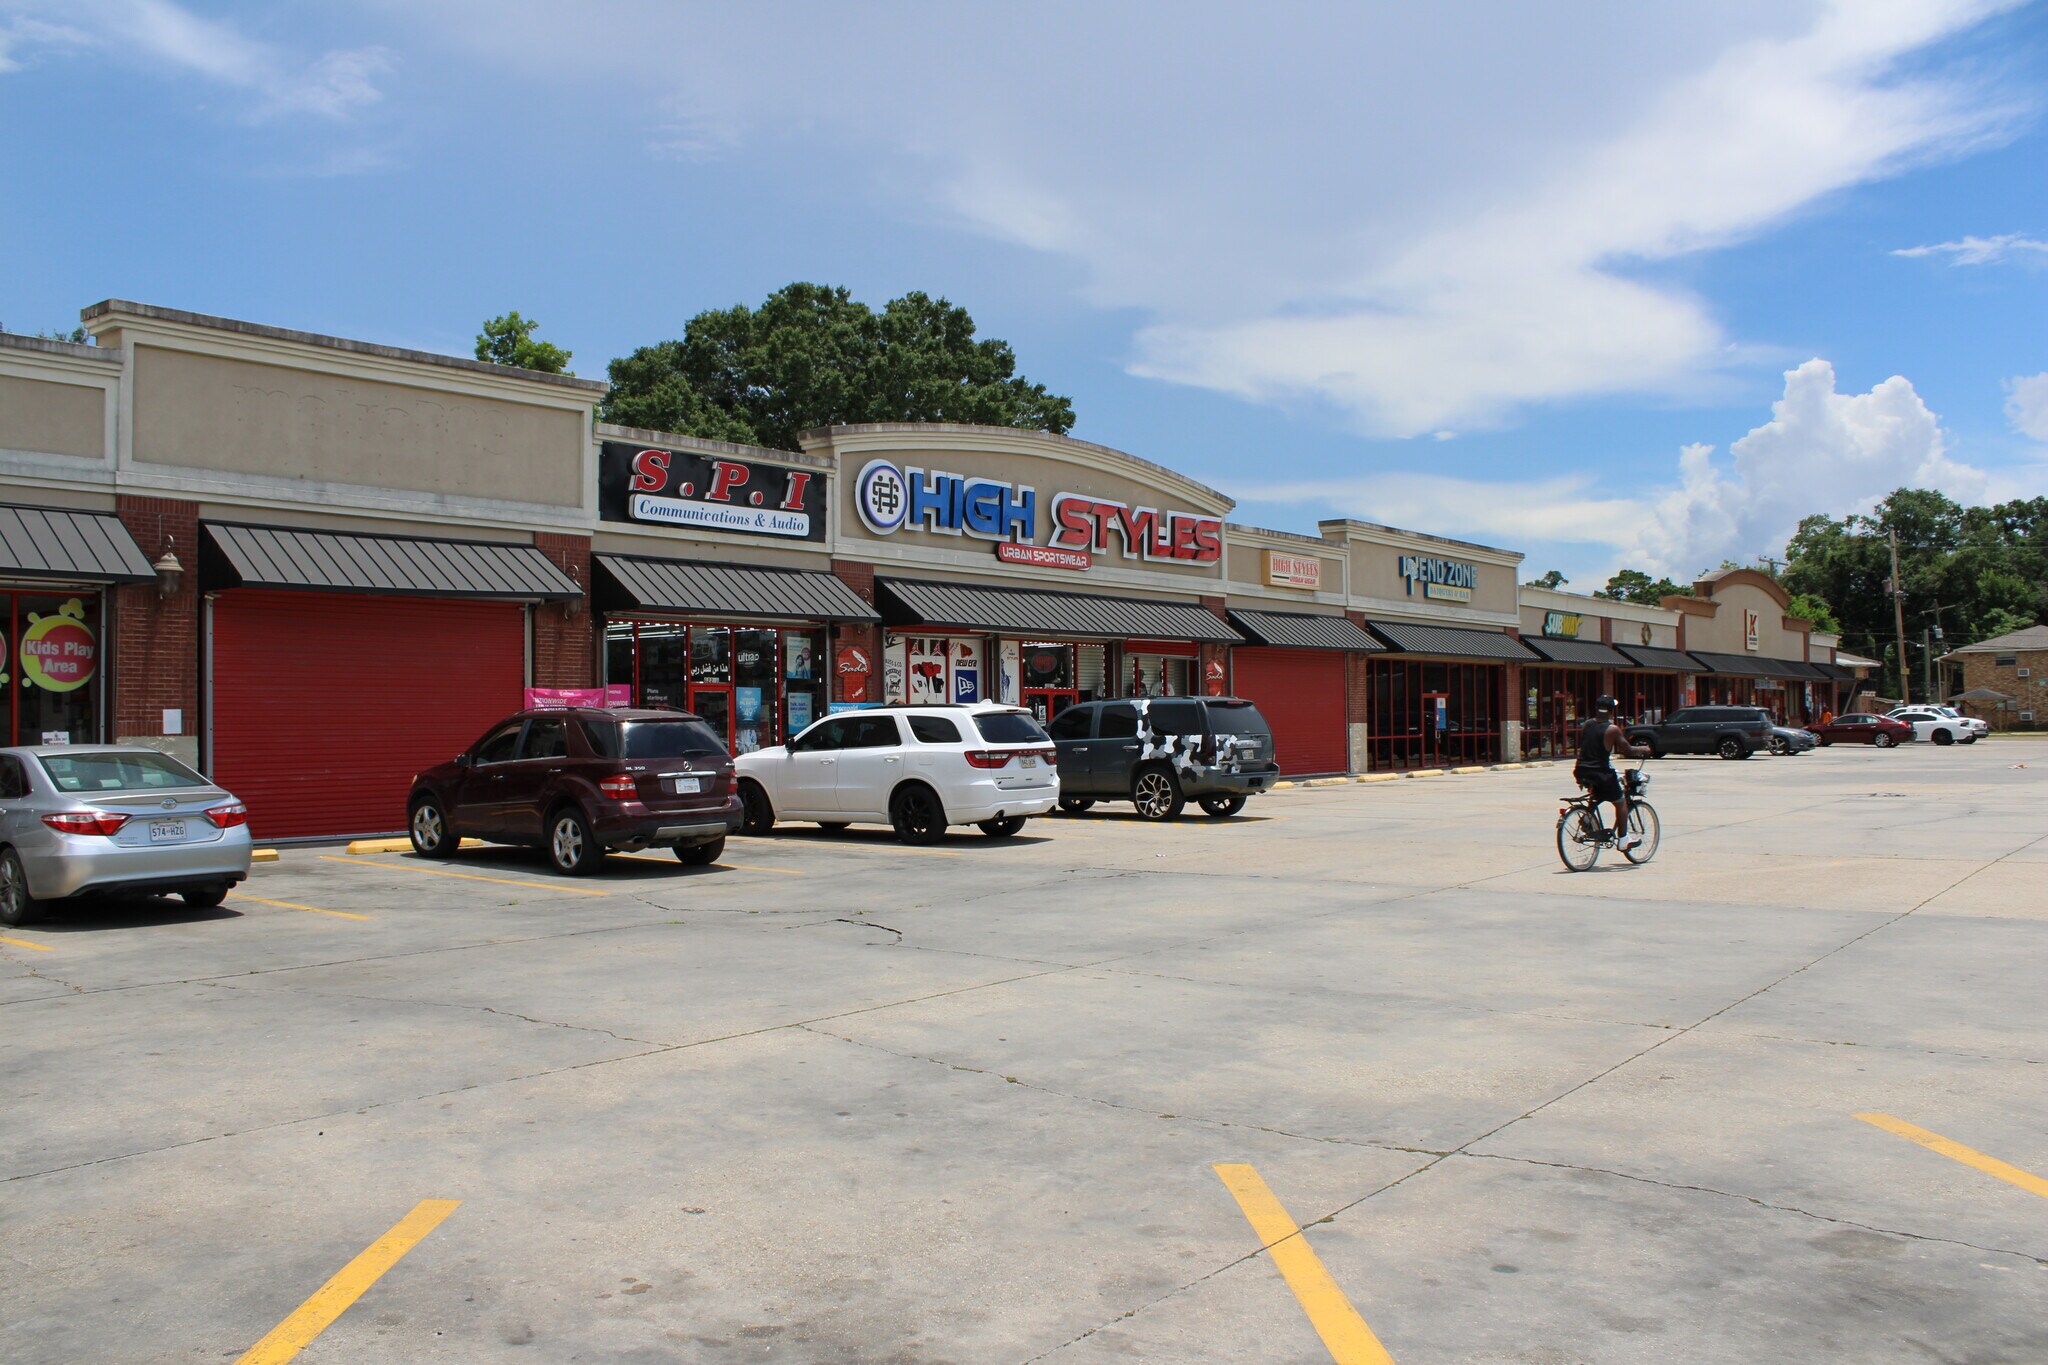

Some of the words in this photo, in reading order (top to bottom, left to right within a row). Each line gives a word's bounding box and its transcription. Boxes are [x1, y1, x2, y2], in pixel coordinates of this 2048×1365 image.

[639, 500, 750, 526] Communications
[754, 513, 766, 528] &
[769, 514, 805, 532] Audio
[907, 470, 1036, 541] HIGH
[1057, 497, 1222, 562] STYLES
[1002, 546, 1033, 559] URBAN
[1033, 551, 1088, 567] SPORTSWEAR
[1272, 558, 1291, 573] HIGH
[1293, 561, 1319, 577] STYLES
[1446, 561, 1478, 589] ZONE
[1545, 612, 1583, 636] SUBWAY
[1749, 614, 1757, 636] K
[26, 640, 59, 655] Kids
[64, 641, 95, 659] Play
[42, 659, 78, 674] Area
[152, 827, 167, 837] 574
[170, 826, 185, 836] HZG
